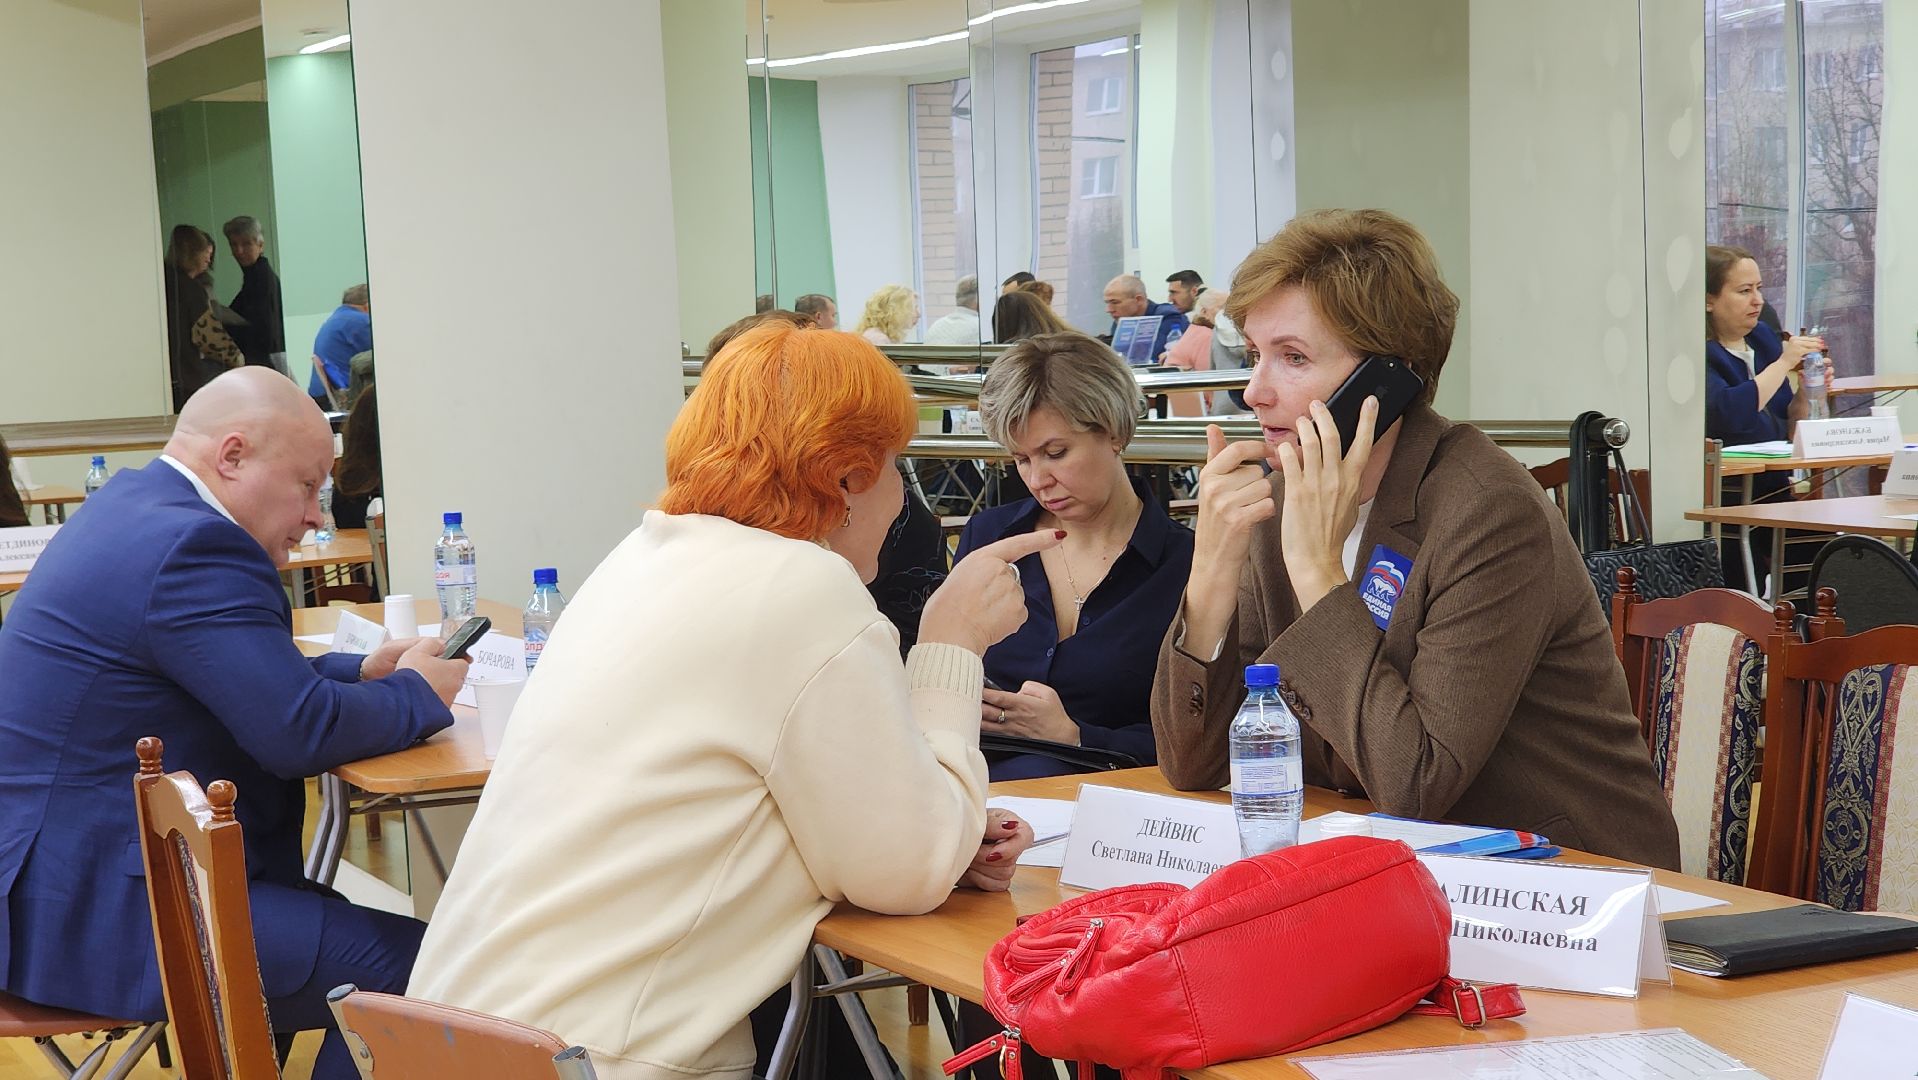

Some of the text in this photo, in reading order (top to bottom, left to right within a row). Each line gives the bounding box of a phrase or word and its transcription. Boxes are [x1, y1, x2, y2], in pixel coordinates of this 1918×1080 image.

[1362, 592, 1392, 612] ЕДИНАЯ
[1363, 600, 1390, 620] ССИЯ
[477, 650, 515, 670] БОЧАРОВА
[1136, 816, 1206, 844] ДЕЙВИС
[1091, 839, 1224, 875] Светлана Николае
[1453, 919, 1598, 952] Николаевна
